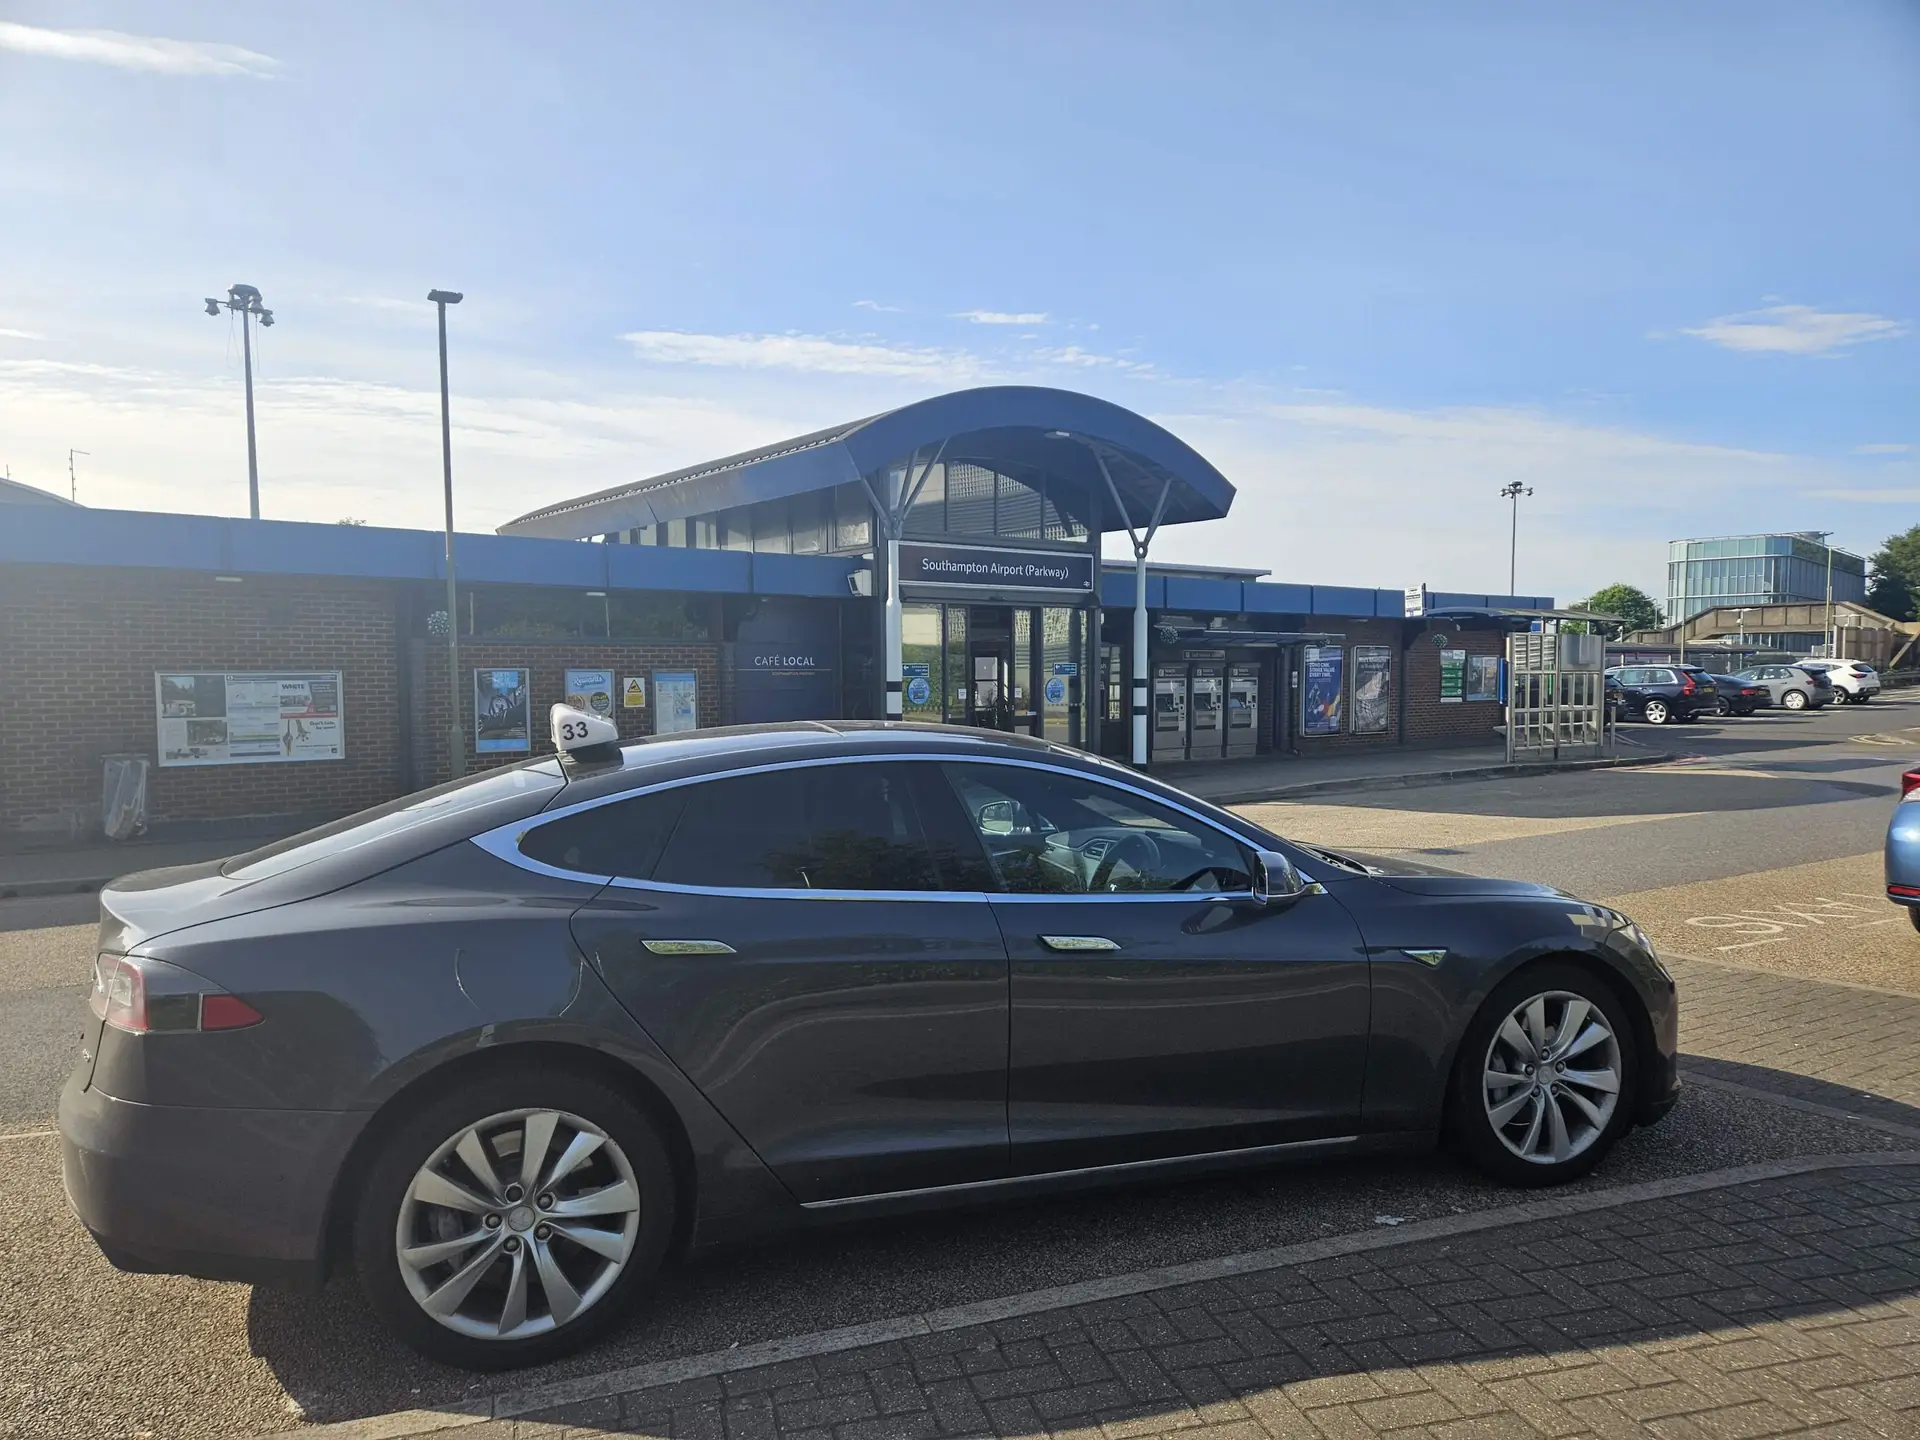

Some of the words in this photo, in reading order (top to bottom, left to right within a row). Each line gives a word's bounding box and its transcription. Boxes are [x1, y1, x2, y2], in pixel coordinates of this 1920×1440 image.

[922, 558, 988, 574] Southampton
[991, 561, 1024, 576] Airport
[1025, 563, 1069, 579] (Parkway)
[754, 654, 780, 666] CAFÉ
[783, 656, 815, 666] LOCAL
[573, 673, 604, 686] Rewards
[562, 721, 589, 741] 33
